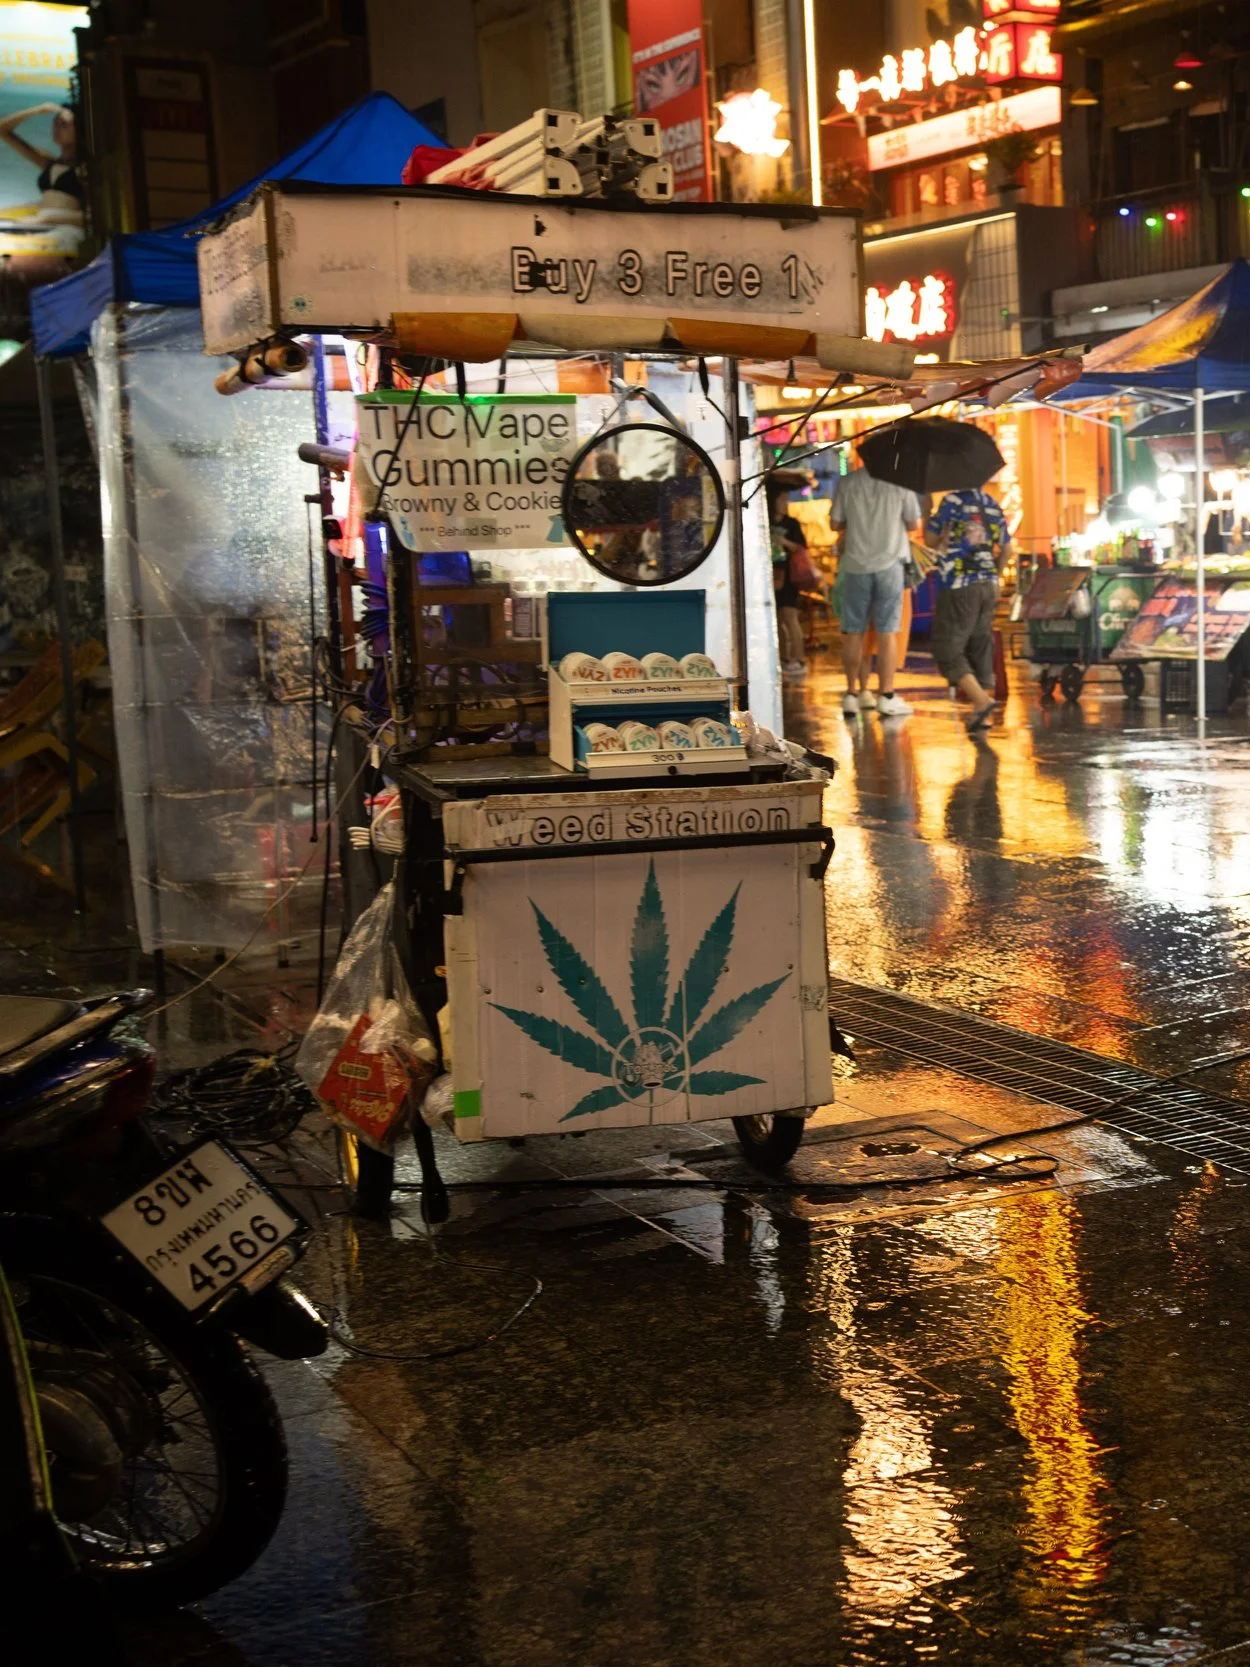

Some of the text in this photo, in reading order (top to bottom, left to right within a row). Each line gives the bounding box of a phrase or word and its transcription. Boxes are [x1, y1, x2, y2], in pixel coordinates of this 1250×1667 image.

[511, 245, 801, 303] Buy 3 Free 1
[364, 405, 569, 446] THC Vape
[372, 449, 571, 487] Gummies
[382, 492, 457, 516] Browny
[463, 492, 480, 511] &
[438, 524, 512, 537] Behind Shop
[611, 685, 682, 695] Nicotine Pouches
[651, 754, 676, 763] 300
[487, 805, 790, 847] Weed Station
[145, 1181, 261, 1272] กรุงเทพมหานคร
[189, 1215, 279, 1294] 4566
